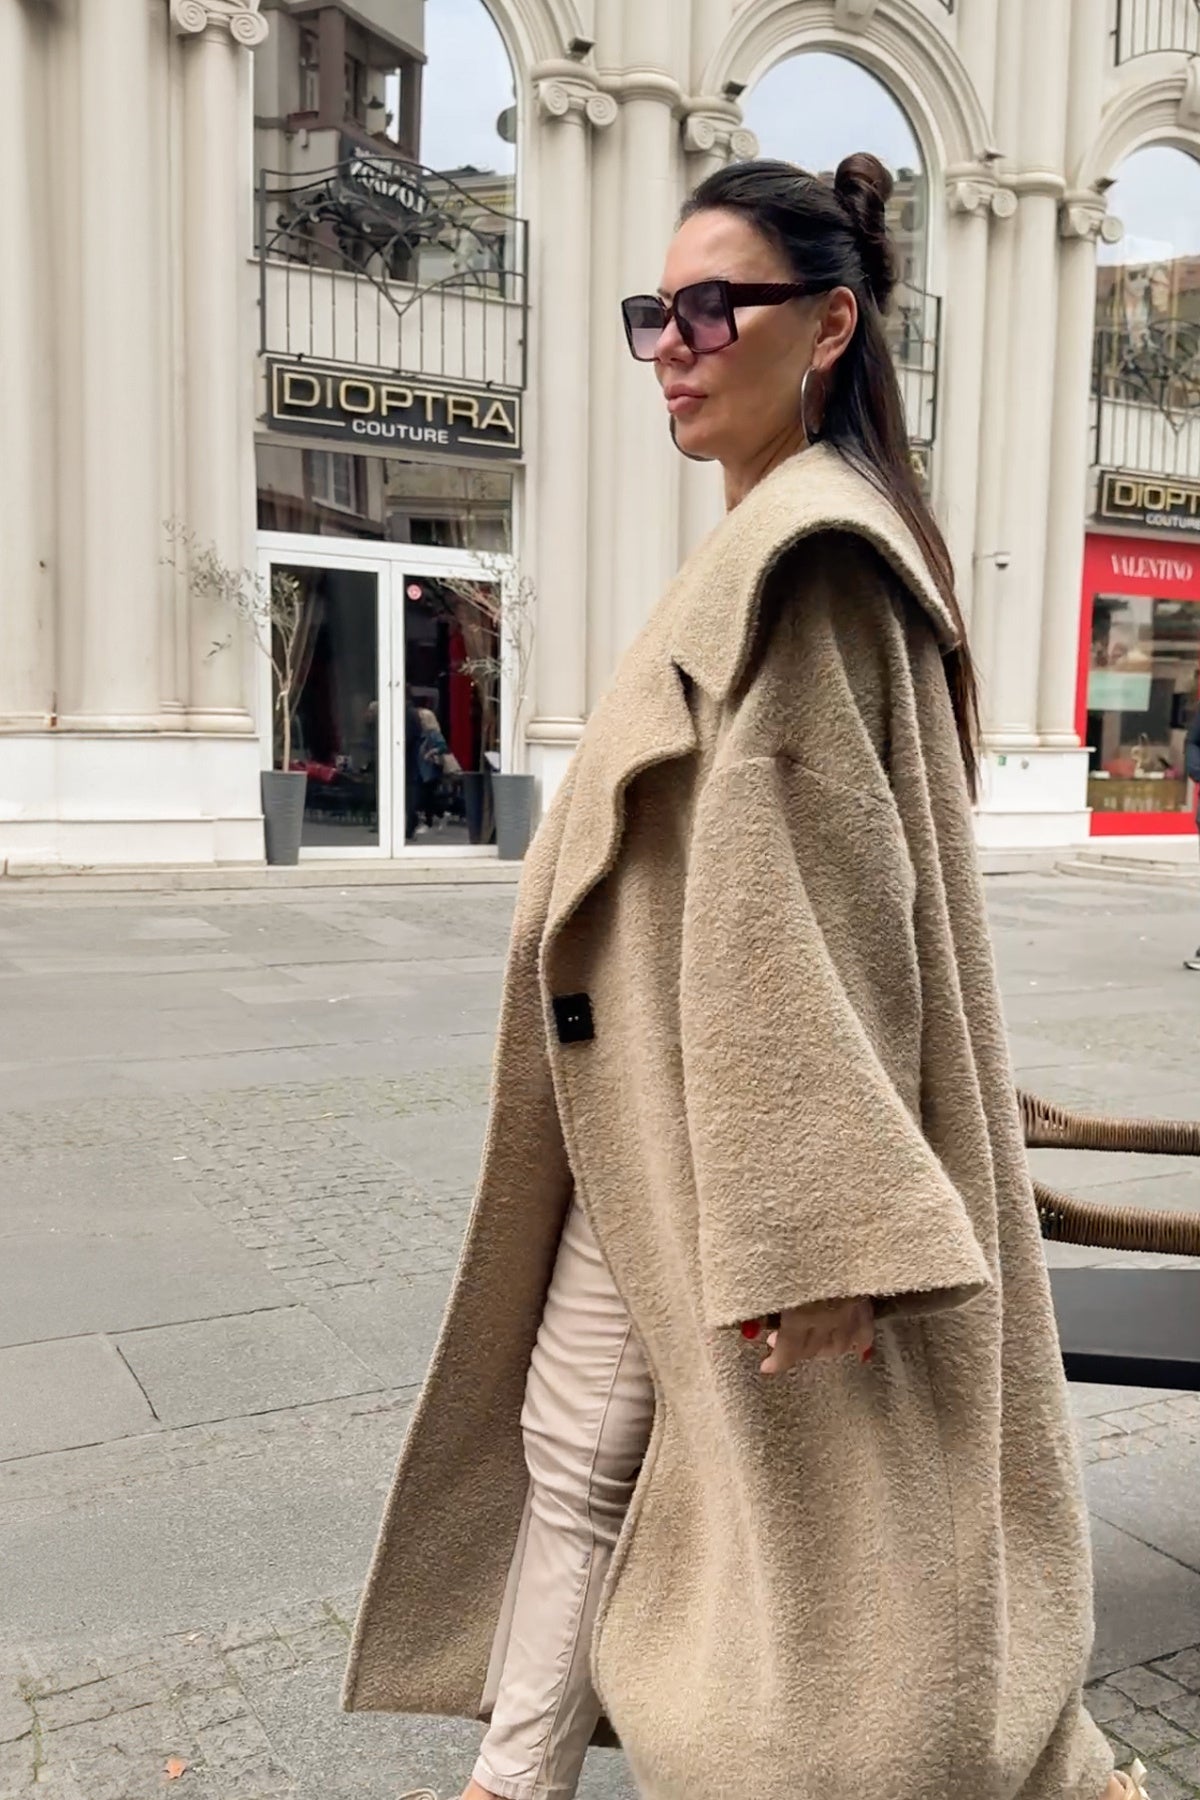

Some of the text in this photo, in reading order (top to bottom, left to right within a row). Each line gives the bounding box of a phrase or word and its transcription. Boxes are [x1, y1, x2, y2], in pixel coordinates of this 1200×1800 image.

[283, 372, 515, 434] DIOPTRA
[352, 419, 450, 445] COUTURE
[1111, 553, 1193, 582] VALENTINO
